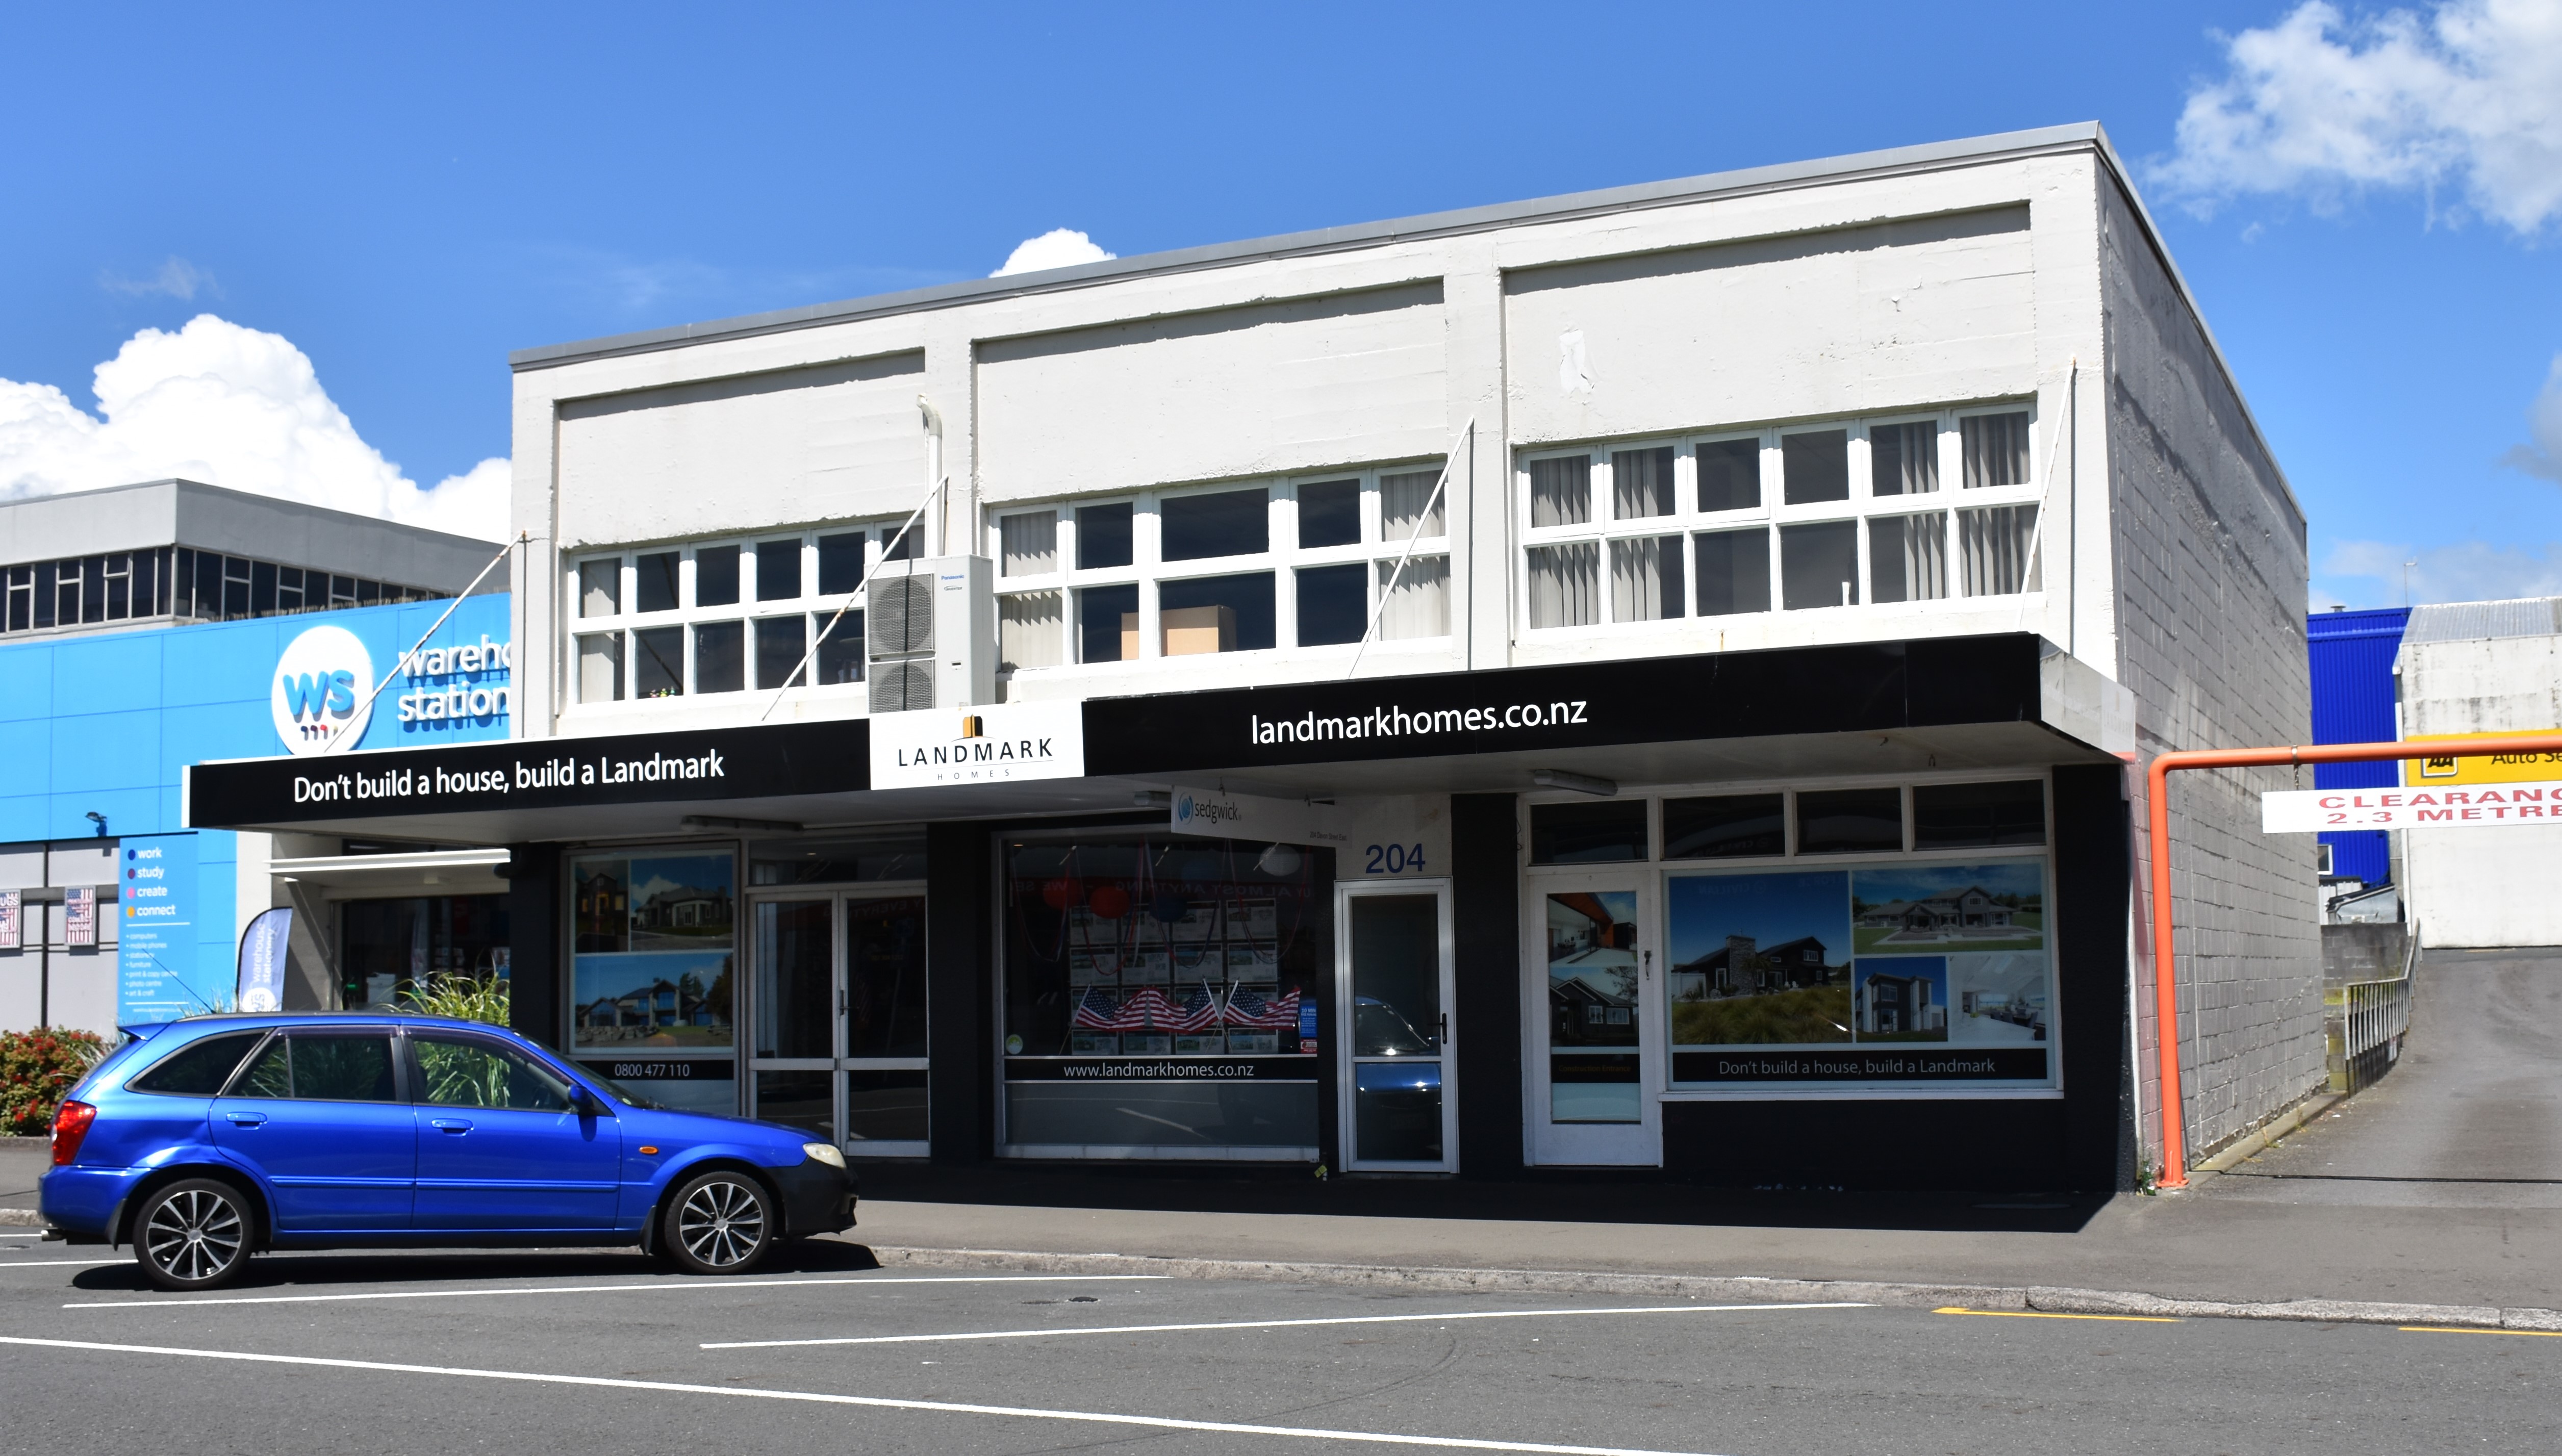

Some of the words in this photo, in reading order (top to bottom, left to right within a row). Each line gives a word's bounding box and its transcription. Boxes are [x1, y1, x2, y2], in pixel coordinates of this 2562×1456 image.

[283, 670, 354, 716] WS
[1252, 700, 1587, 744] landmarkhomes.co.nz
[898, 737, 1053, 767] LANDMARK
[294, 774, 351, 803] Don’t
[357, 769, 412, 799] build
[417, 775, 430, 795] a
[437, 767, 510, 794] house,
[516, 757, 574, 788] build
[581, 764, 594, 785] a
[602, 749, 725, 783] Landmark
[937, 769, 1009, 781] HOMES
[1195, 799, 1238, 824] sedgwick
[2327, 811, 2393, 824] 2.3
[137, 847, 162, 858] work
[1365, 843, 1426, 874] 204
[137, 866, 164, 879] study
[137, 886, 168, 897] create
[137, 904, 176, 916] connect
[252, 923, 265, 982] warehouse
[263, 928, 276, 983] stationery
[615, 1064, 642, 1077] 0800
[645, 1064, 666, 1076] 477
[670, 1064, 690, 1077] 110
[1063, 1062, 1254, 1077] www.landmarkhomes.co.nz
[1719, 1061, 1758, 1075] Don’t
[1761, 1060, 1797, 1075] build
[1802, 1063, 1810, 1074] a
[1814, 1060, 1861, 1076] house,
[1866, 1058, 1903, 1074] build
[1907, 1062, 1916, 1073] a
[1920, 1057, 1996, 1073] Landmark
